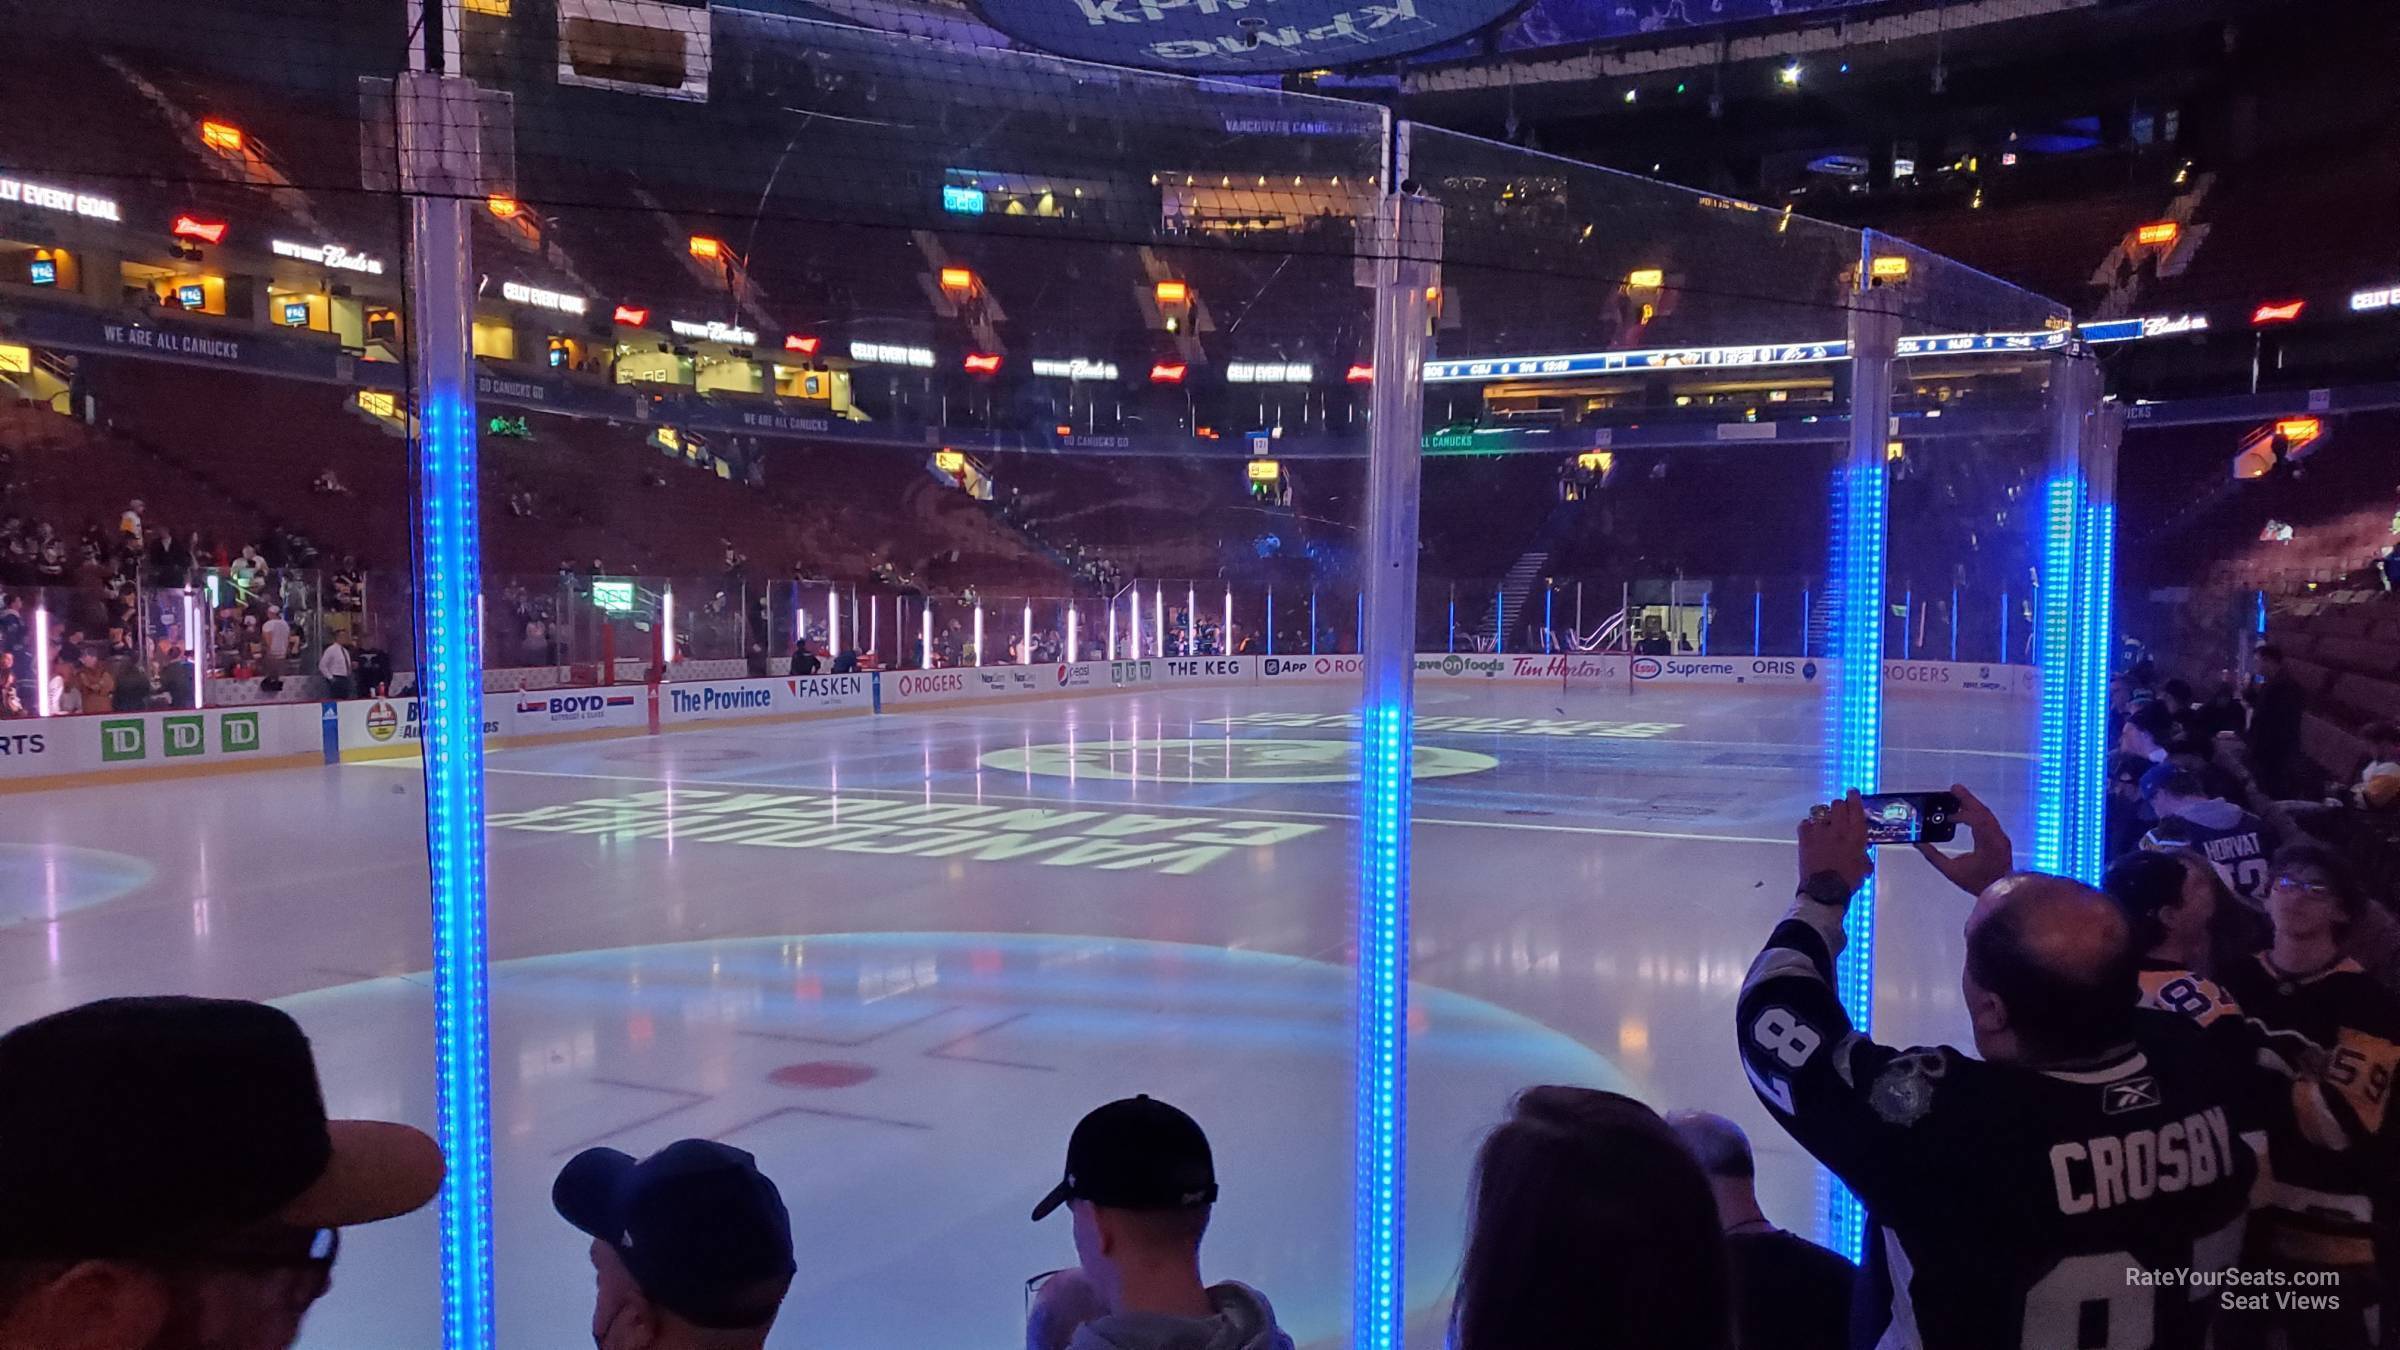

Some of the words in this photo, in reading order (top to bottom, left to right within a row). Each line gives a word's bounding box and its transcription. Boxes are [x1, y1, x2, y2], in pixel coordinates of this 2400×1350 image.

[22, 183, 75, 212] EVERY
[76, 194, 121, 222] GOAL
[2351, 290, 2390, 310] CELLY
[103, 325, 124, 342] WE
[128, 328, 152, 347] ARE
[157, 332, 179, 351] ALL
[182, 336, 239, 359] CANUCKS
[1227, 363, 1255, 382] CELLY
[1255, 363, 1286, 382] EVERY
[1432, 436, 1473, 448] CANUCKS
[1168, 661, 1198, 676] THE
[1205, 660, 1240, 675] KEG
[1464, 657, 1505, 671] foods
[1512, 656, 1543, 676] Tim
[1666, 660, 1733, 678] Supreme
[1752, 660, 1795, 675] ORIS
[800, 676, 861, 697] FASKEN
[915, 674, 963, 693] ROGERS
[550, 695, 604, 713] BOYD
[671, 689, 701, 713] The
[704, 686, 771, 712] Province
[105, 726, 142, 753] TD
[167, 722, 200, 749] TD
[225, 719, 256, 745] TD
[574, 790, 1326, 846] CANUCKS
[2203, 832, 2261, 862] HORVAT
[2050, 1105, 2233, 1215] CROSBY
